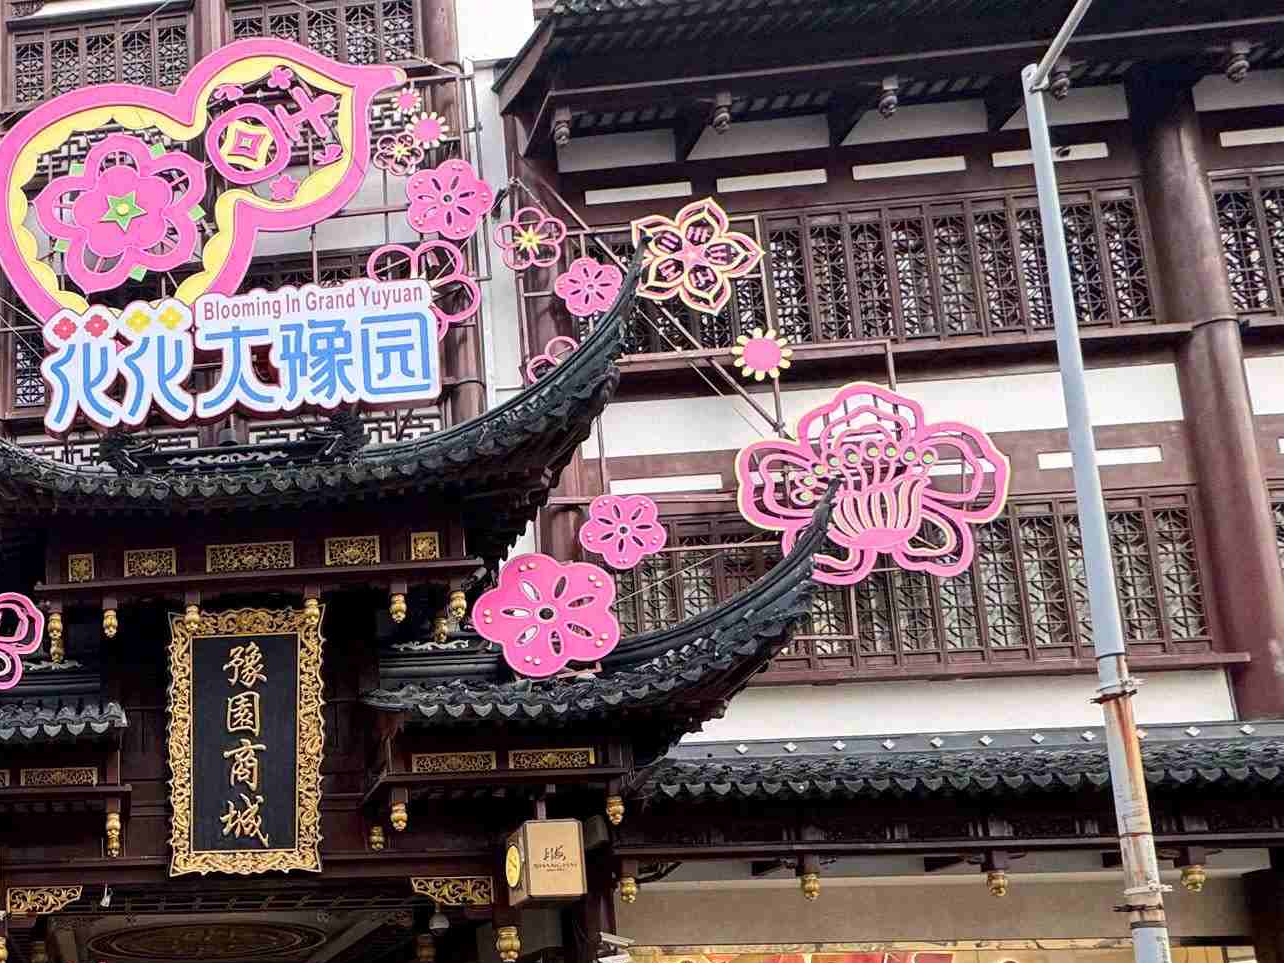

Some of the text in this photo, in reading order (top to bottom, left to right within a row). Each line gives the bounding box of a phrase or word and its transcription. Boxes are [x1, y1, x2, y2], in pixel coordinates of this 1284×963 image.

[203, 286, 423, 322] Blooming In Grand Yuyuan
[219, 641, 269, 847] 豫園商城
